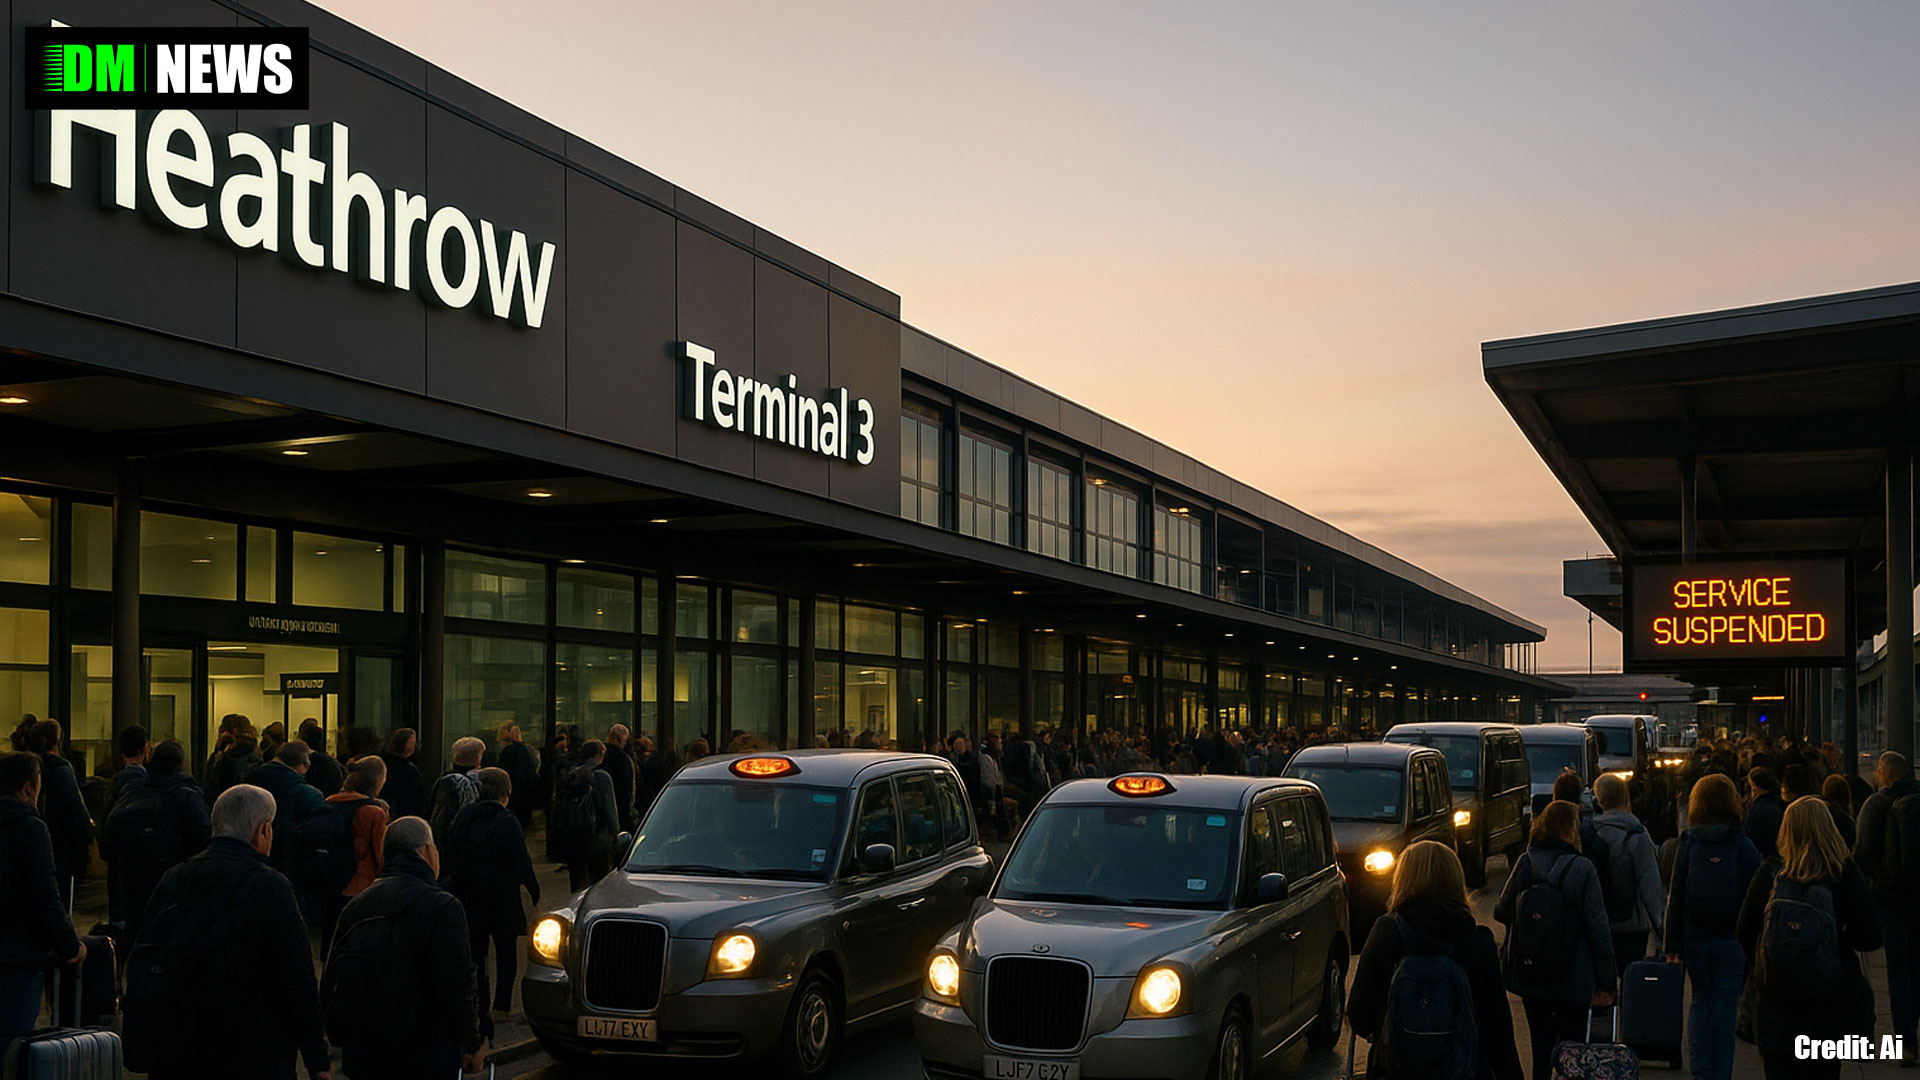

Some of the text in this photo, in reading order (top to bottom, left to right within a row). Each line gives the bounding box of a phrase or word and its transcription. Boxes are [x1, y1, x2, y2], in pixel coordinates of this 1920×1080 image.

[686, 341, 875, 465] Terminal 3
[1673, 577, 1791, 608] SERVICE
[1653, 613, 1825, 644] SUSPENDED
[622, 1021, 649, 1038] EXY
